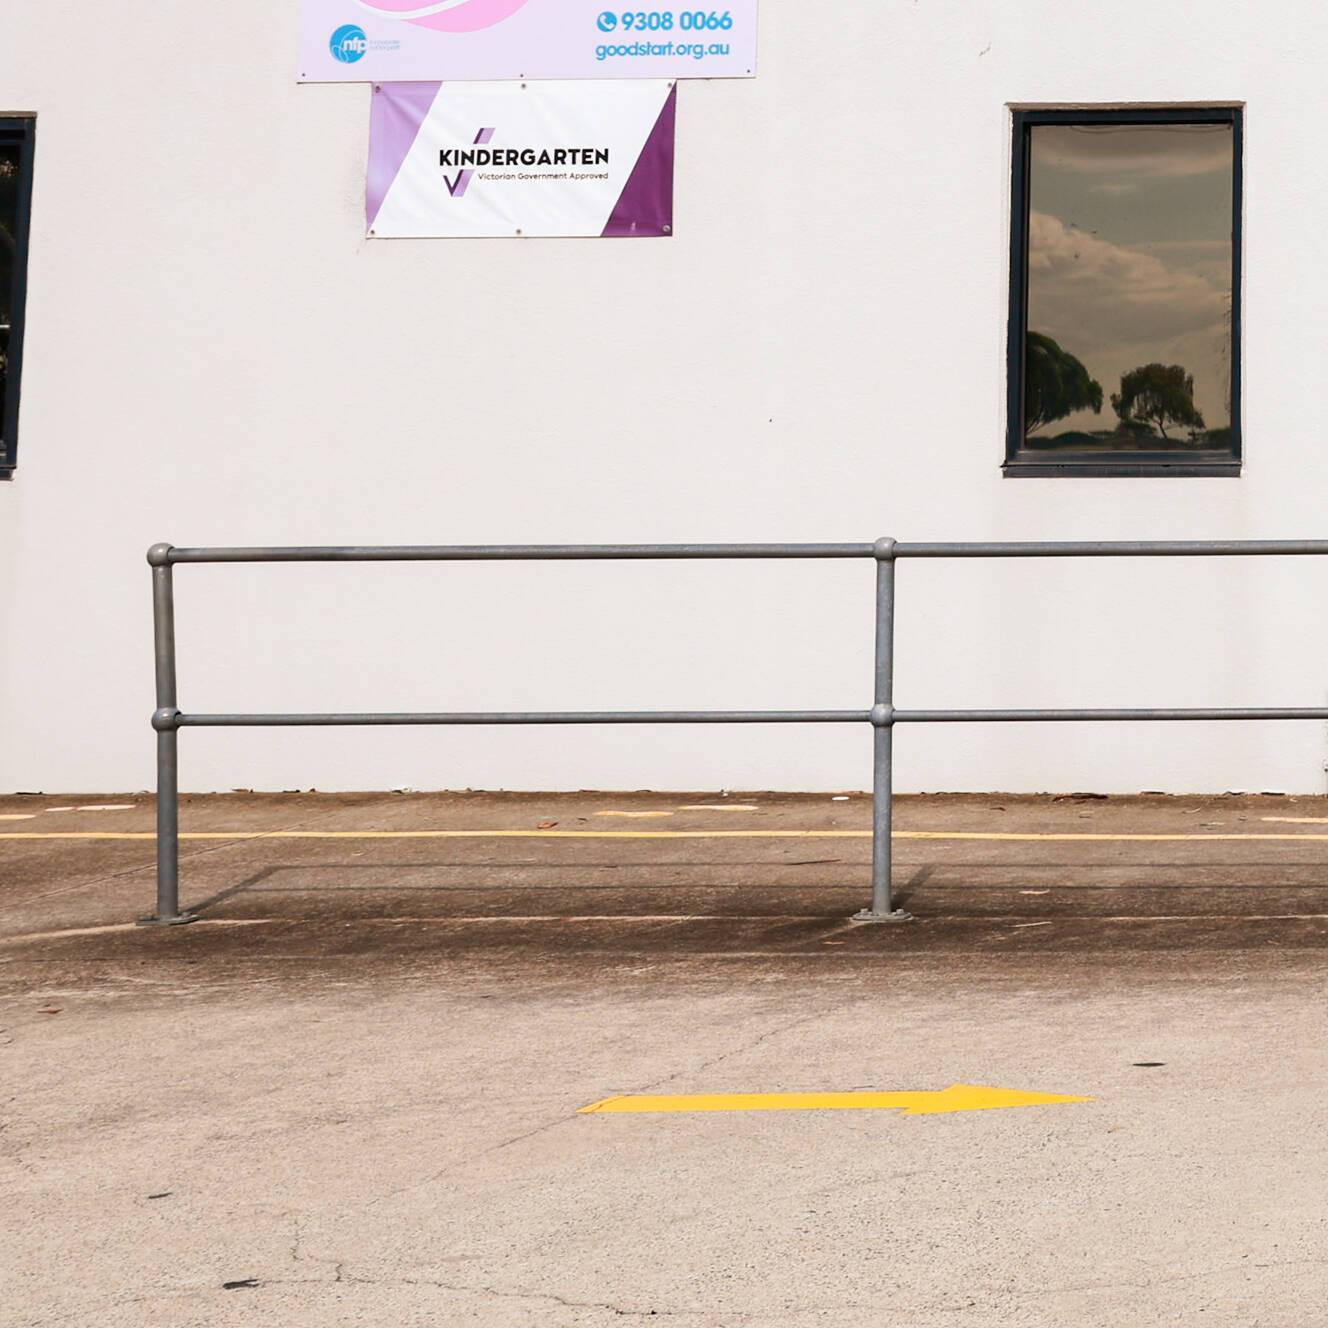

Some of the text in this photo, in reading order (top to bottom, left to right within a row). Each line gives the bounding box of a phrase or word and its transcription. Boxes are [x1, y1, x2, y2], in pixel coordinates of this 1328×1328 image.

[621, 10, 734, 31] 9308 0066
[595, 41, 730, 61] goodstart.org.au
[439, 147, 609, 166] KINDERGARTEN
[478, 172, 609, 181] Victorian Government Approved
